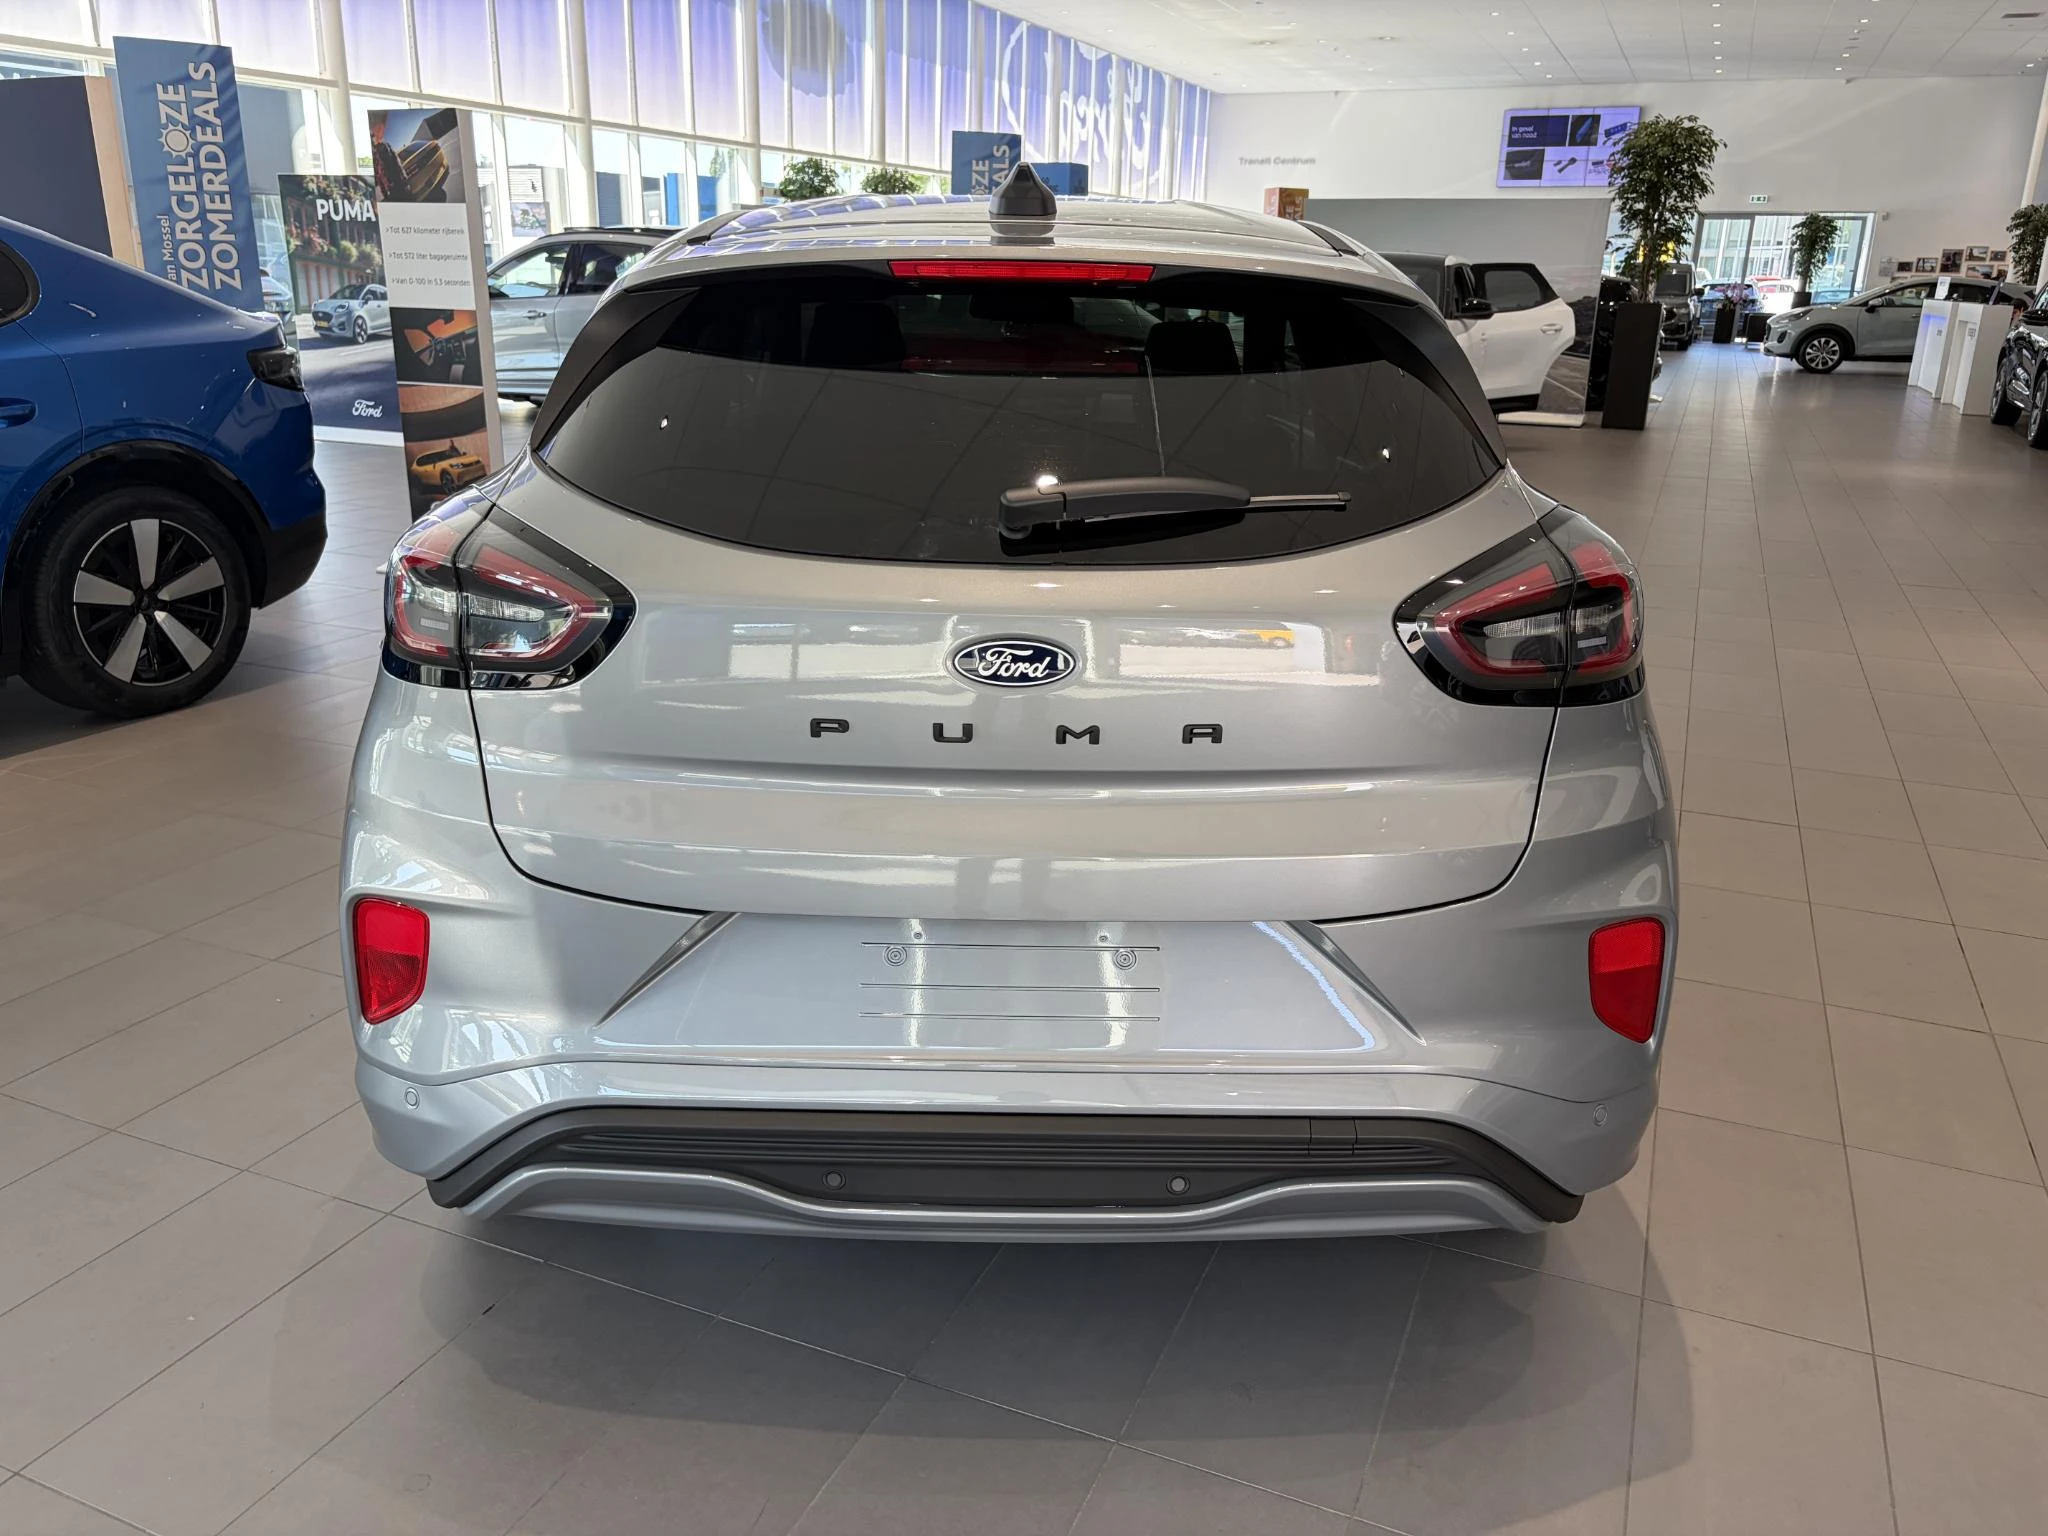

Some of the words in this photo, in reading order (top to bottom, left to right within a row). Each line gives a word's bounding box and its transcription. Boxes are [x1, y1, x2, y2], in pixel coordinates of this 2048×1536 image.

[1273, 156, 1316, 165] Centrum
[188, 62, 242, 291] ZOMERDEALS
[315, 198, 376, 222] PUMA
[156, 215, 175, 261] Mossel
[413, 226, 440, 234] kilometer
[166, 265, 177, 281] an
[351, 399, 383, 418] Ford
[976, 646, 1050, 679] Ford
